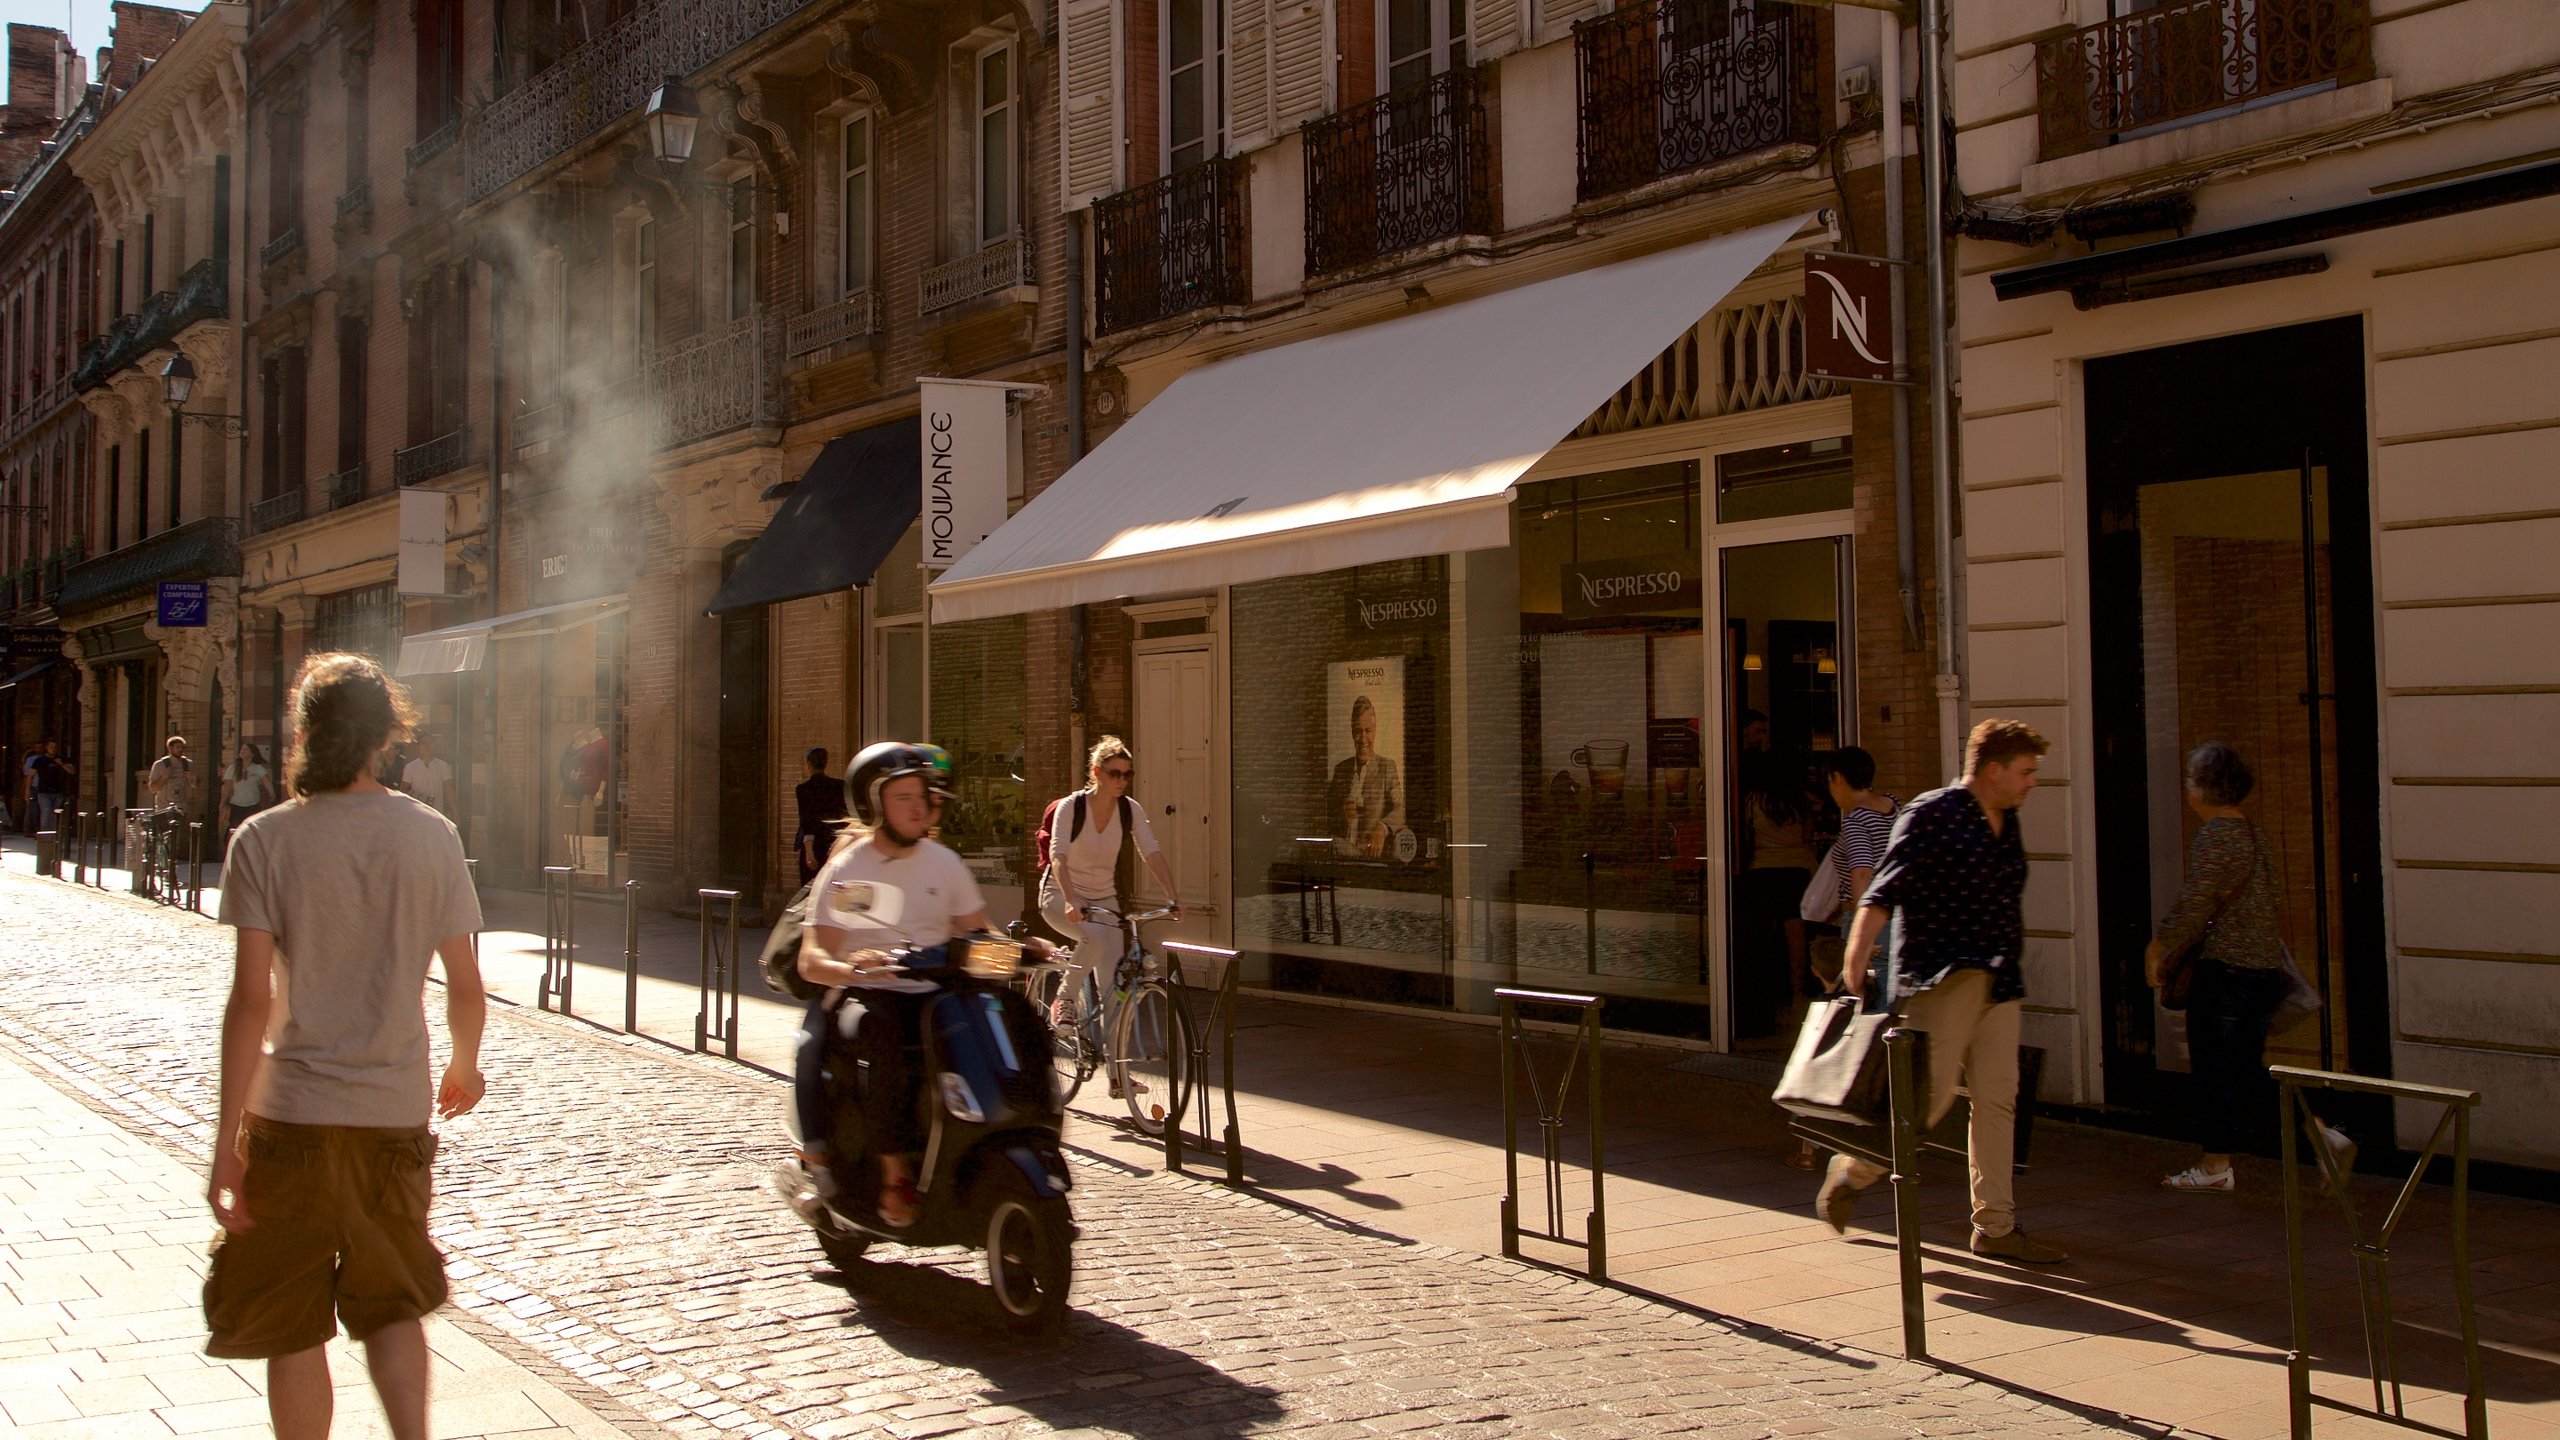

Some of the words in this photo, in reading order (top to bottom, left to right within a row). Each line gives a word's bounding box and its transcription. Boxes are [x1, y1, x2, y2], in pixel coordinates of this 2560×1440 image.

[1808, 270, 1890, 364] N
[931, 412, 953, 558] MOUVANCE
[589, 527, 618, 537] ERIC
[1576, 571, 1681, 607] NESPRESSO
[1357, 598, 1437, 629] NESPRESSO
[1347, 667, 1384, 680] NESPRESSO
